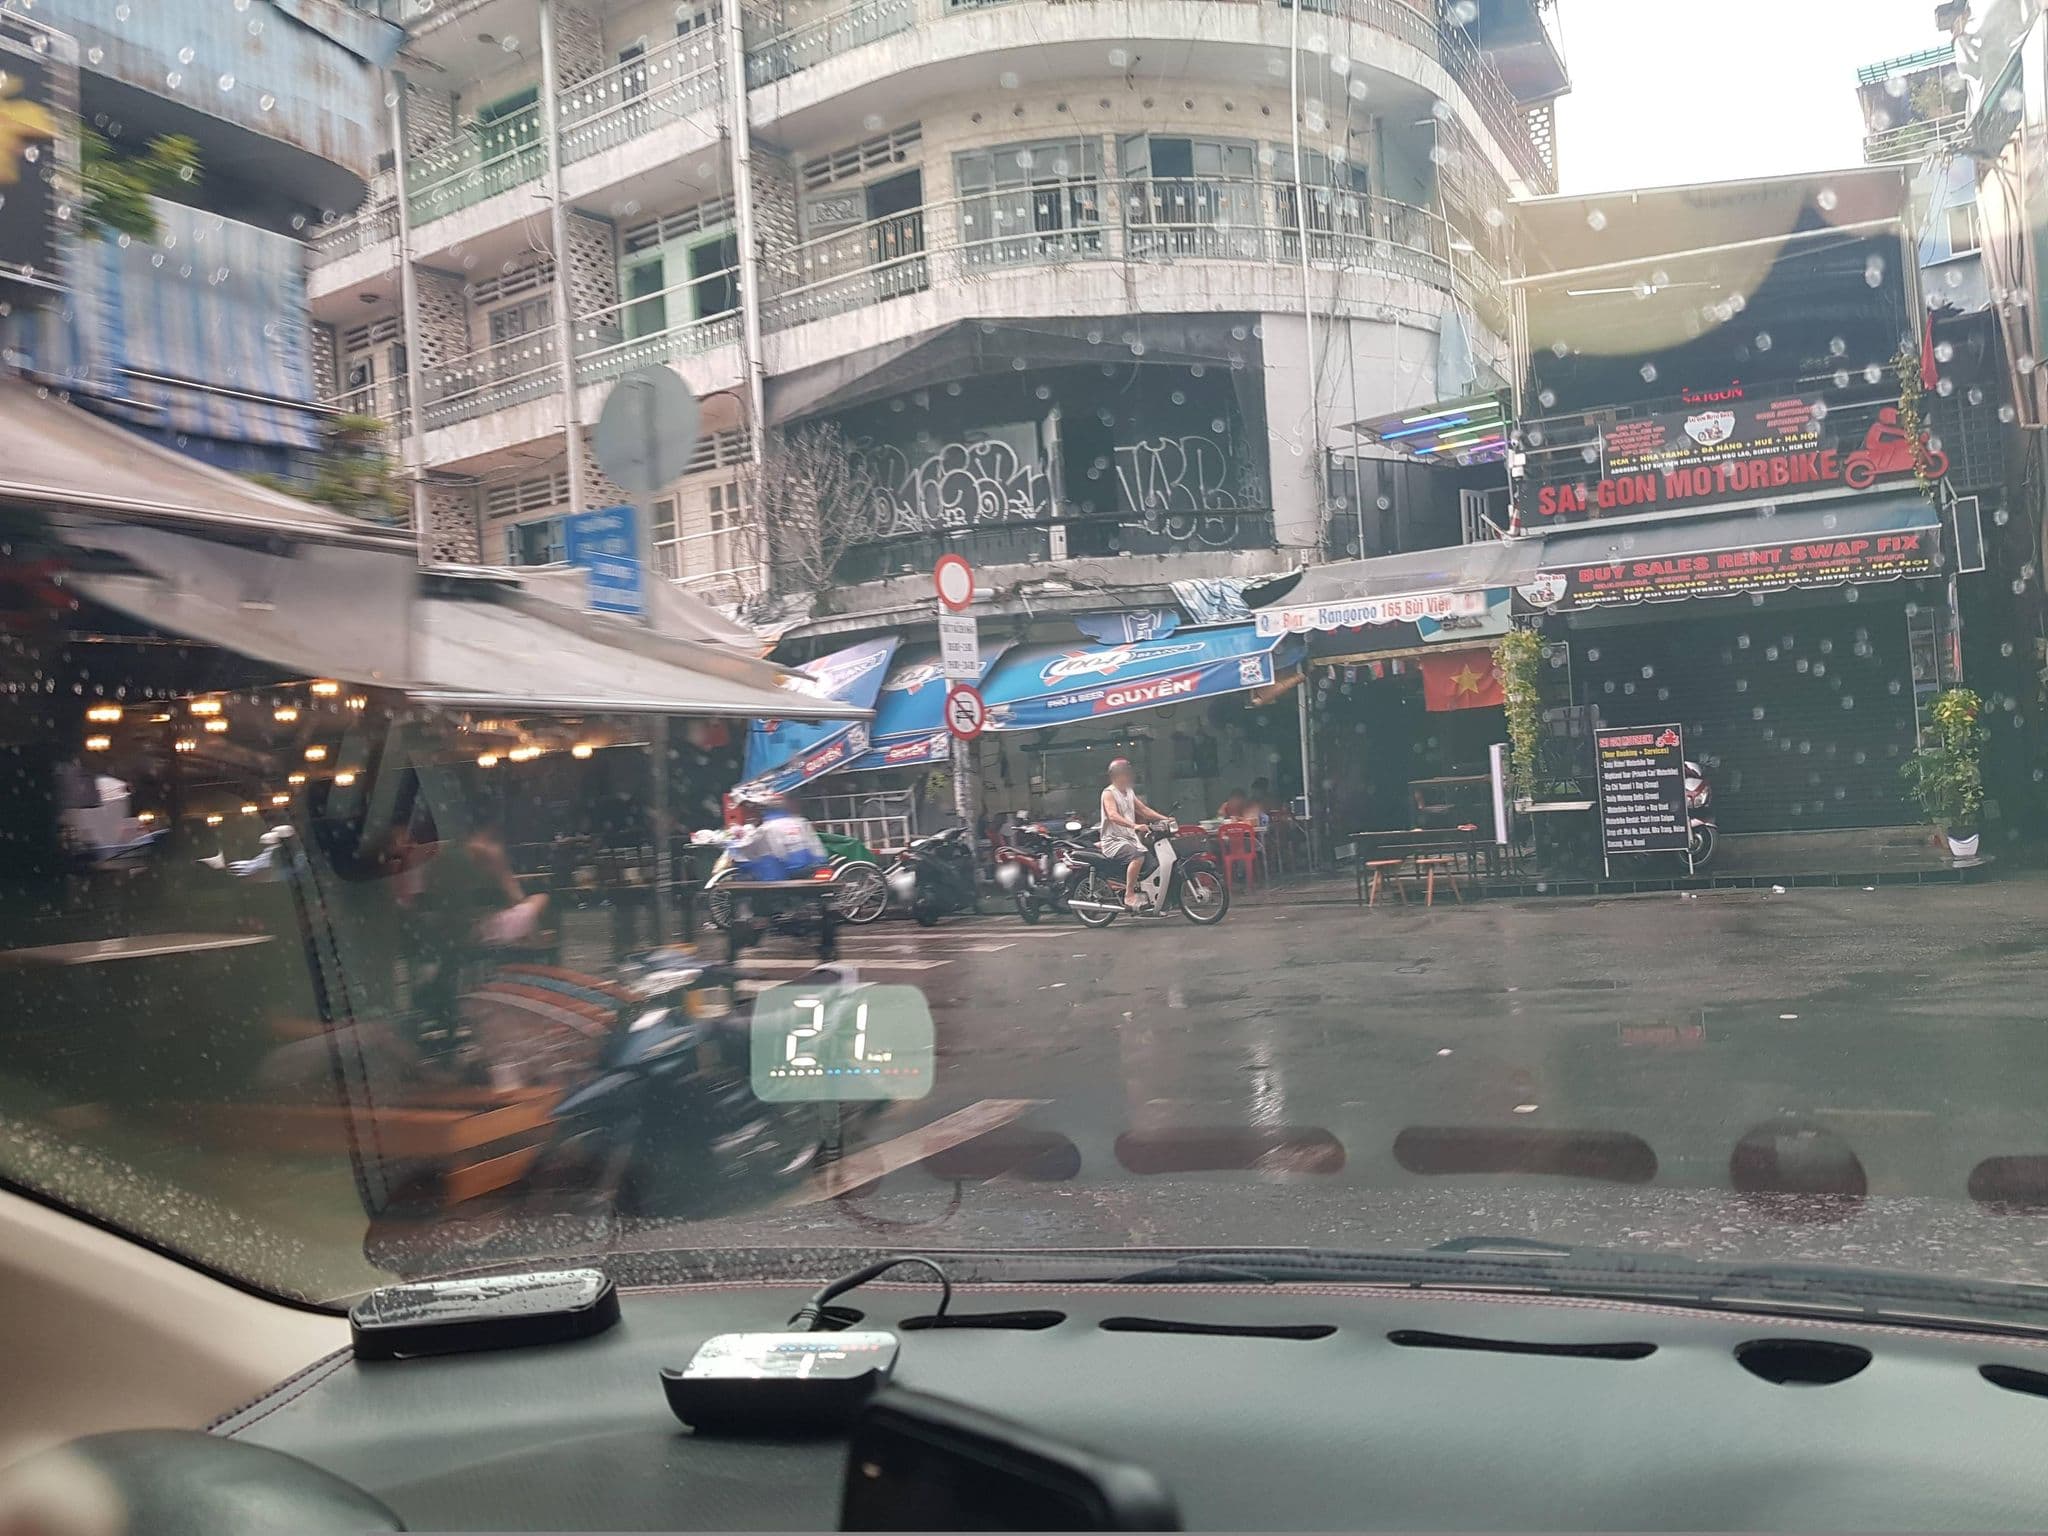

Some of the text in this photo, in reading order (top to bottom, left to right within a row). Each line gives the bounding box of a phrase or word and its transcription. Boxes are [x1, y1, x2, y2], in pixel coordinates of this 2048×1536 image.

[1804, 441, 1818, 449] CITY
[1610, 459, 1630, 468] HCM
[1640, 455, 1659, 463] NHA
[1661, 450, 1690, 460] TRANG
[1538, 448, 1840, 516] SAI GON MOTORBIKE
[1579, 535, 1920, 583] BUY SALES RENT SWAP FIX
[1815, 572, 1862, 582] DISTRICT
[1905, 566, 1928, 574] CITY
[1573, 591, 1604, 599] HCM
[1623, 586, 1655, 594] NHA
[1658, 581, 1708, 590] TRANG
[1319, 604, 1377, 626] Kangoroo
[1381, 601, 1403, 618] 165
[785, 998, 868, 1067] 21
